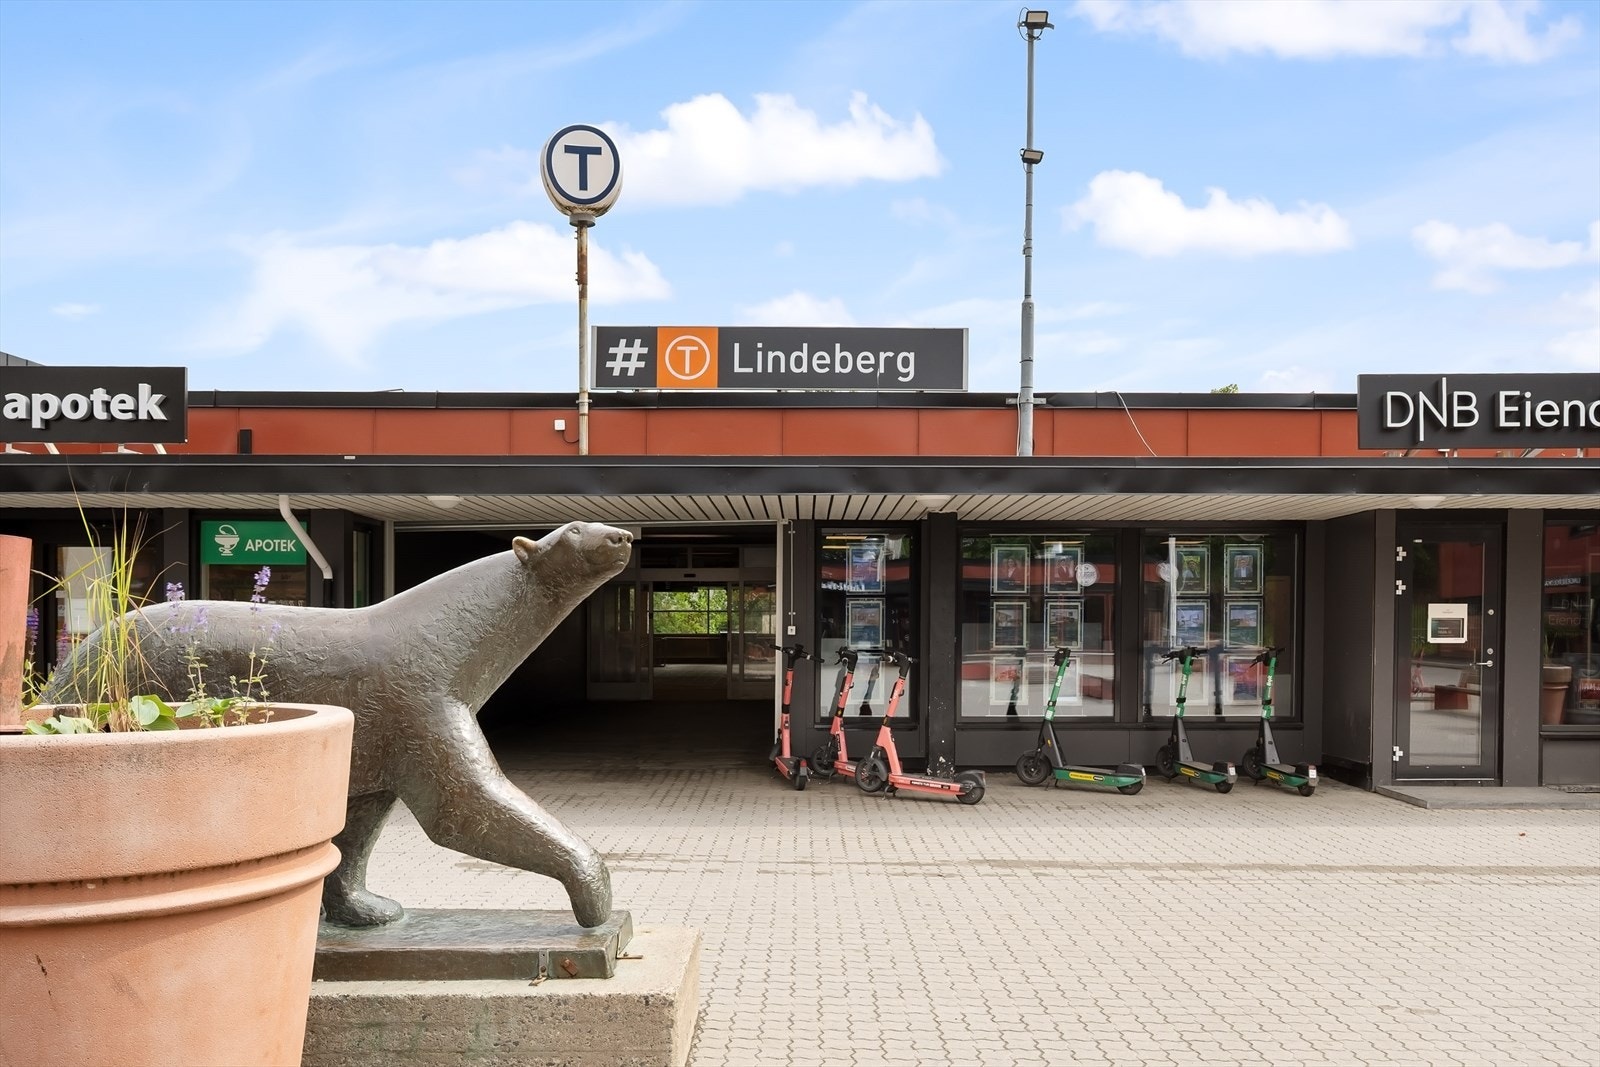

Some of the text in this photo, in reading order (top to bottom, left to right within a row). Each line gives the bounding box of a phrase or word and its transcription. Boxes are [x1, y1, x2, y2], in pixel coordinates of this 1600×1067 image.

[564, 144, 602, 191] T
[733, 342, 916, 382] Lindeberg
[3, 383, 168, 429] apotek
[1386, 377, 1480, 442] DNB
[244, 538, 297, 553] APOTEK
